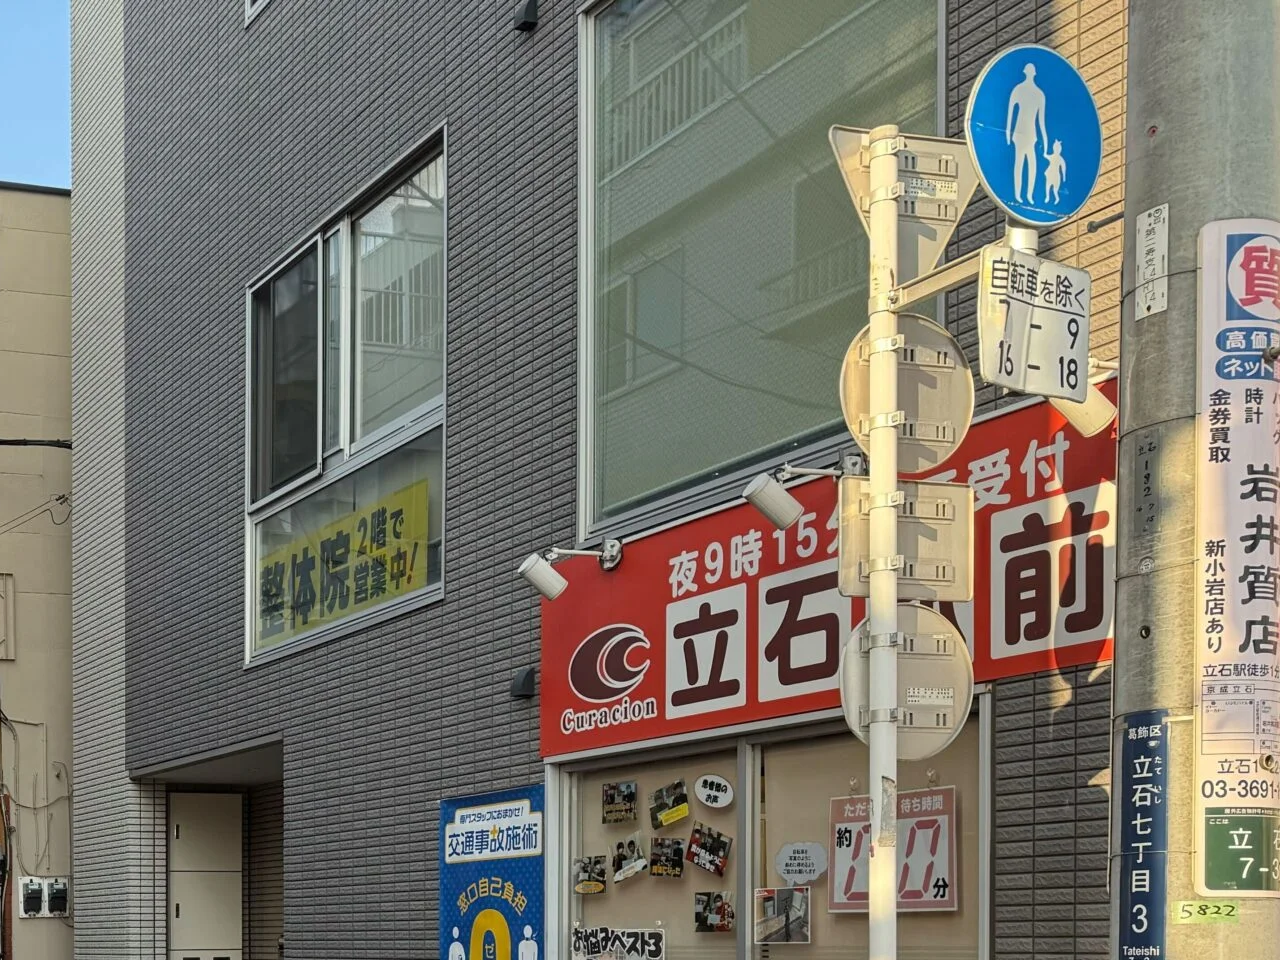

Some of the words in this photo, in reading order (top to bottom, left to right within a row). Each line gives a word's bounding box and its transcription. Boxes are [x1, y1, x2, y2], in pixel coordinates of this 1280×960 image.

[992, 257, 1085, 311] 自転車を除く
[1067, 318, 1080, 350] 9
[998, 340, 1013, 377] 16
[1059, 356, 1078, 390] 18
[1209, 388, 1231, 463] 金券買取
[1245, 388, 1263, 424] 時計
[357, 506, 404, 557] 2階で
[1239, 463, 1280, 655] 岩井質店
[260, 529, 350, 640] 整体院
[670, 500, 1112, 706] 立石前
[1205, 539, 1226, 653] 新小岩店あり
[560, 697, 657, 735] Curacion
[1128, 725, 1162, 740] 葛飾区
[448, 823, 538, 857] 交通事故施術
[456, 876, 527, 916] 窓口自己負担
[1180, 904, 1236, 919] 5822
[572, 927, 663, 958] お悩みベスト3
[1123, 946, 1160, 956] Tateishi
